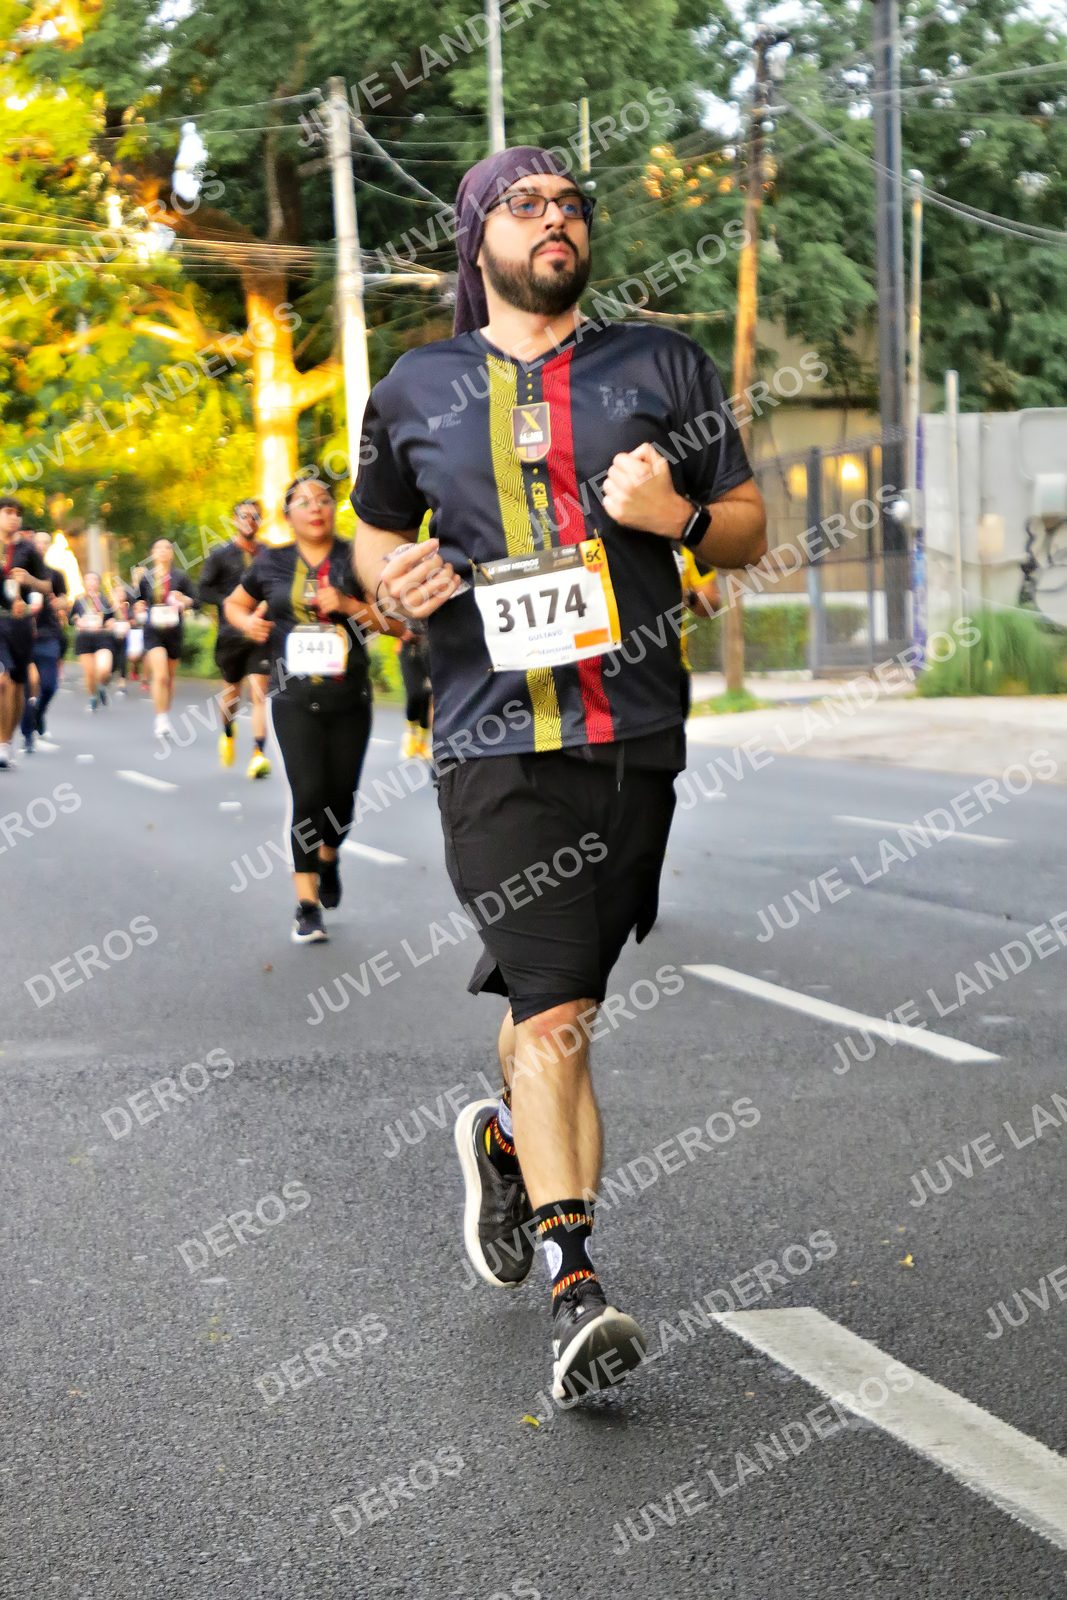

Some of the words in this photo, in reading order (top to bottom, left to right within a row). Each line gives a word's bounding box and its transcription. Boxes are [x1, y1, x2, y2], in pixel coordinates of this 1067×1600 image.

[586, 549, 602, 563] 5K
[496, 584, 587, 633] 3174
[528, 630, 563, 642] GUSTAVO
[297, 640, 334, 655] 3441
